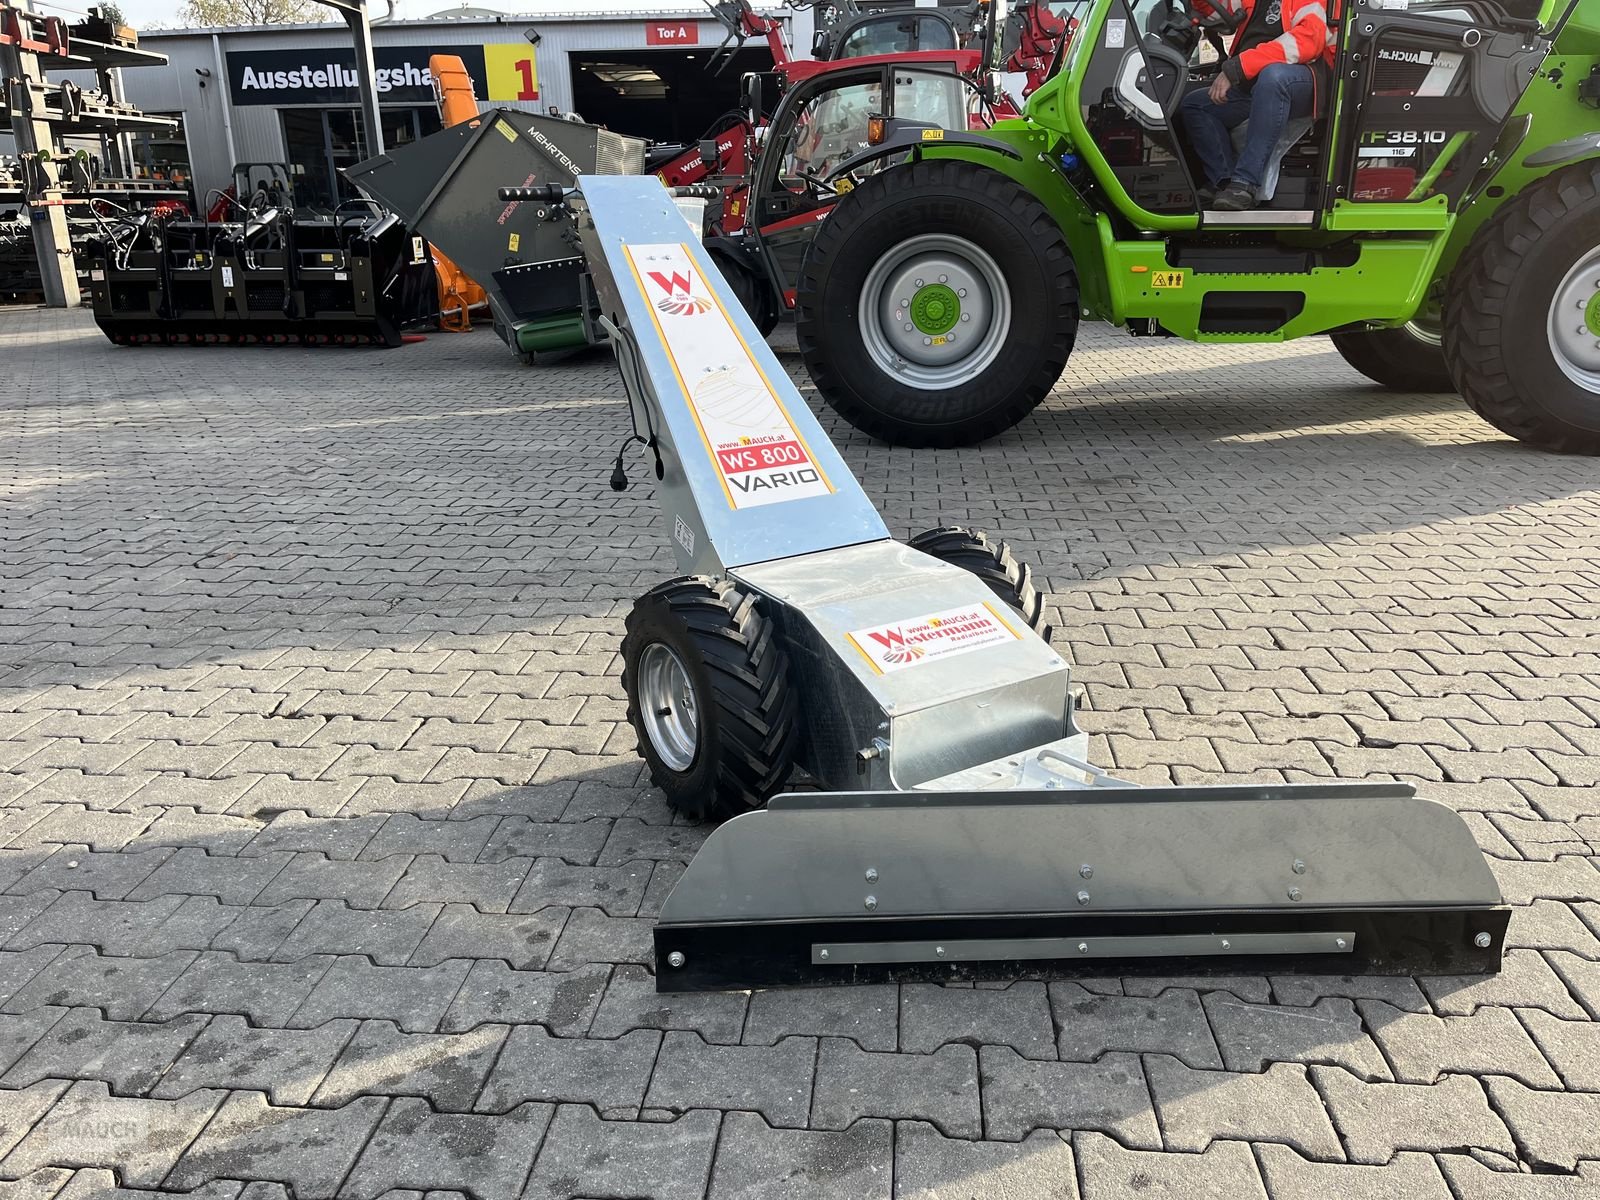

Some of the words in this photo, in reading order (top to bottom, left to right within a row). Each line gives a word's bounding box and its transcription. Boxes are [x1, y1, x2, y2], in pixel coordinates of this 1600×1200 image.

[657, 27, 676, 39] Tor
[678, 26, 687, 38] A
[241, 62, 433, 92] Ausstellugsha
[514, 59, 539, 101] 1
[527, 126, 582, 175] MEHRTENS
[1392, 148, 1406, 156] 116
[646, 269, 691, 296] W
[717, 434, 786, 449] www.MAUCH.at
[722, 451, 758, 470] WS
[761, 445, 800, 465] 800
[728, 468, 819, 493] VARIO
[867, 618, 992, 649] Westermann
[907, 612, 980, 634] www.MAUCH.at
[951, 627, 998, 642] Radialbesen
